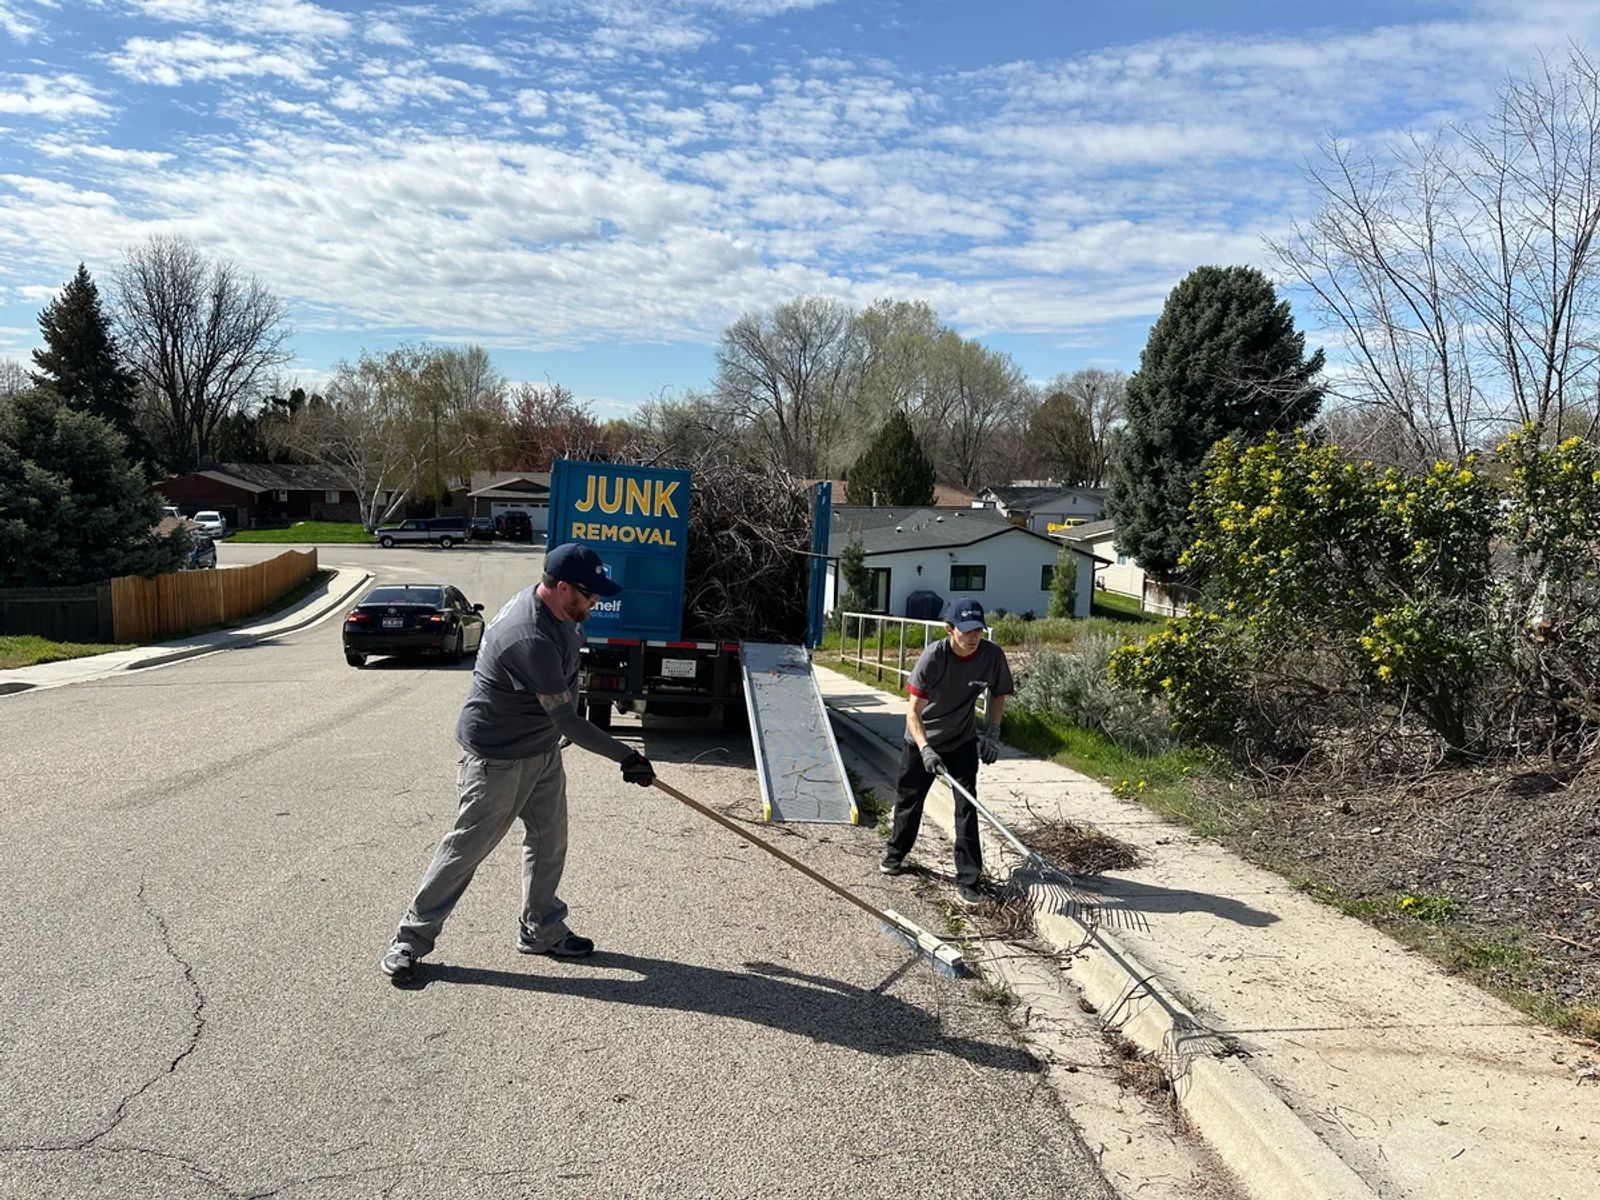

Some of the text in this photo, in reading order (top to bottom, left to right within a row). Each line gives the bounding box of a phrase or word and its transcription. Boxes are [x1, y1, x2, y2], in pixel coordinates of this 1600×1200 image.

[575, 475, 680, 518] JUNK
[572, 522, 677, 546] REMOVAL
[590, 599, 622, 612] helf
